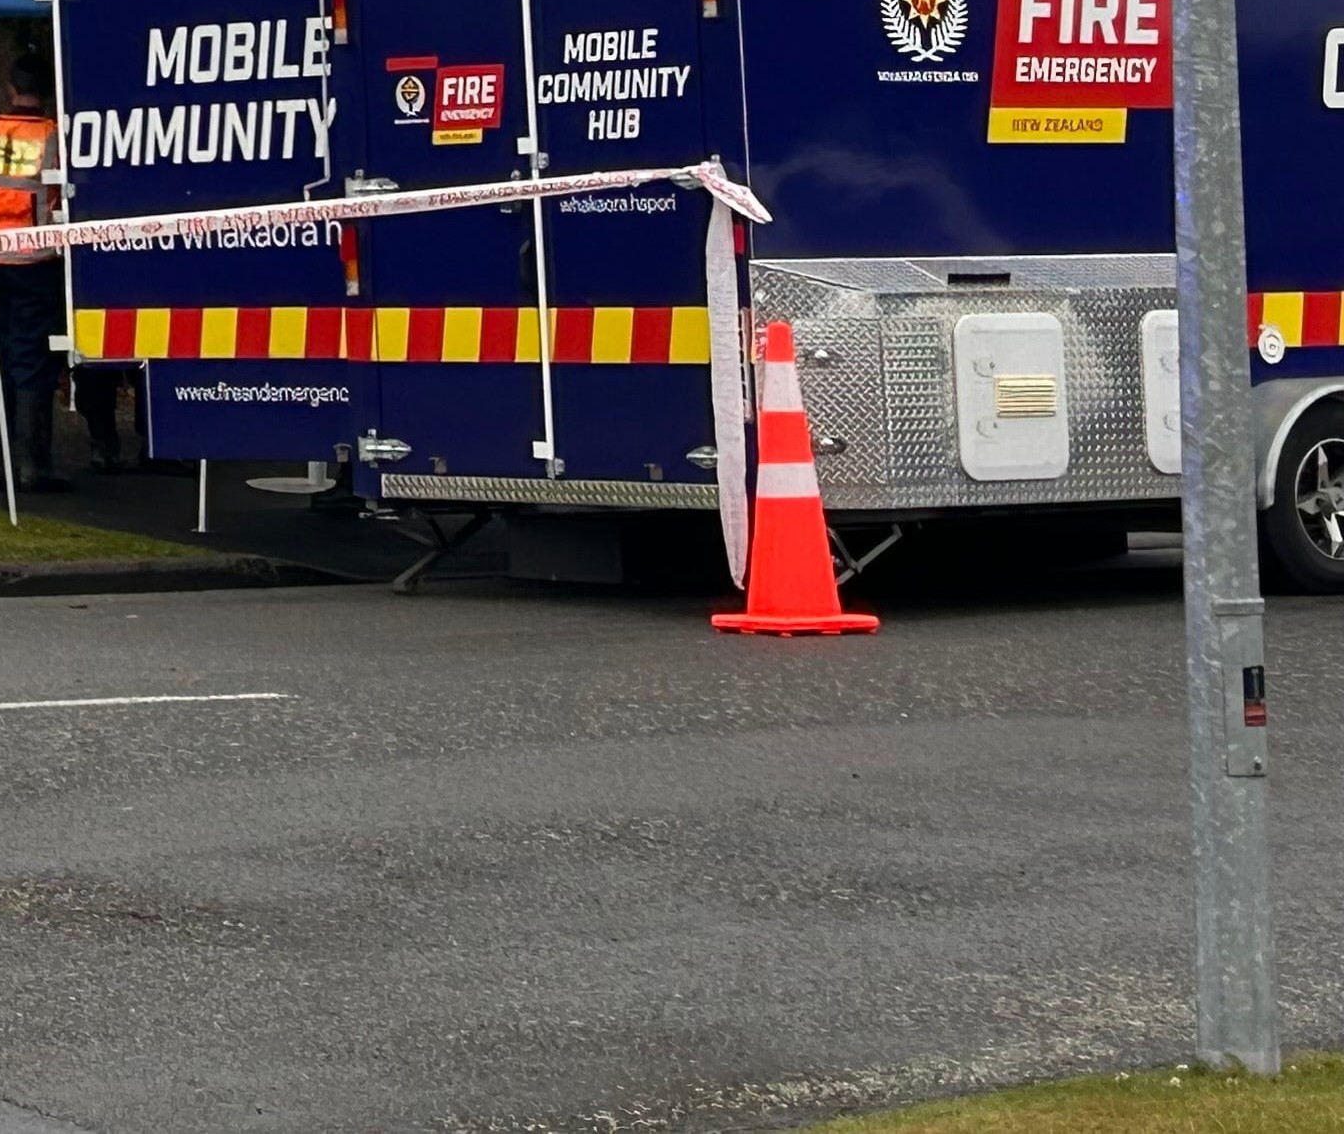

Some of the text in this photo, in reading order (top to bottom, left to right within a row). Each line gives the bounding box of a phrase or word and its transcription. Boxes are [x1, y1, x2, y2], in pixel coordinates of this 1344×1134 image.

[146, 16, 332, 87] MOBILE
[563, 28, 659, 64] MOBILE
[537, 66, 691, 105] COMMUNITY
[1015, 56, 1157, 83] EMERGENCY
[442, 74, 497, 106] FIRE
[64, 97, 337, 168] OMMUNITY
[588, 109, 640, 141] HUB
